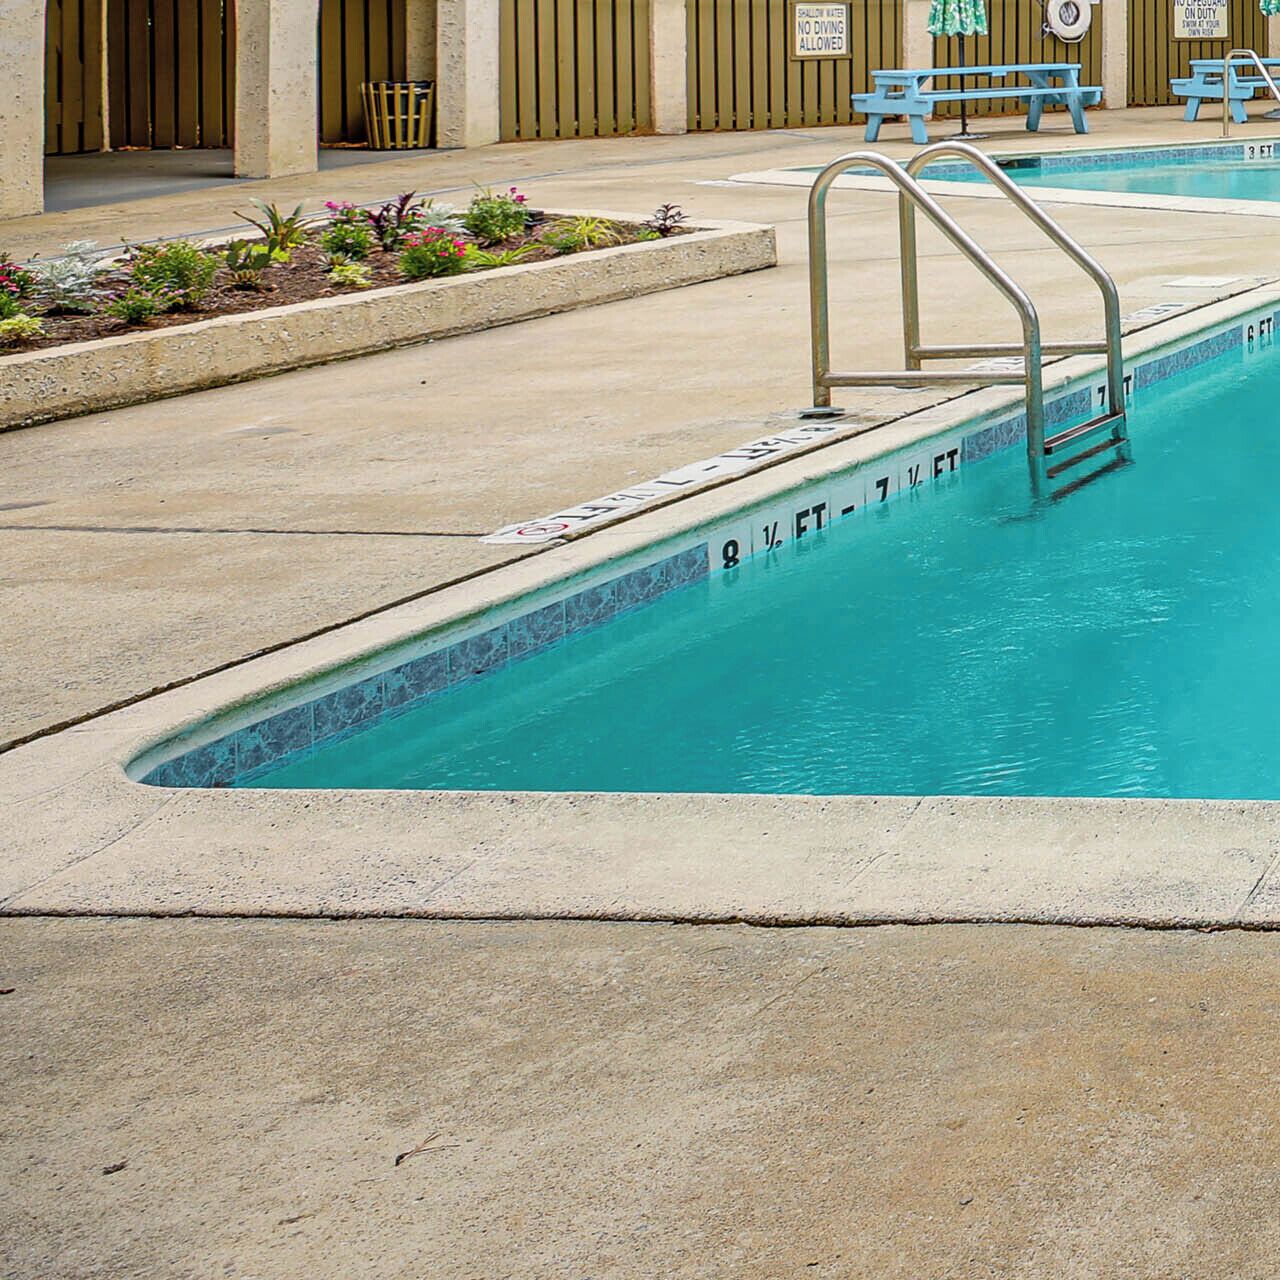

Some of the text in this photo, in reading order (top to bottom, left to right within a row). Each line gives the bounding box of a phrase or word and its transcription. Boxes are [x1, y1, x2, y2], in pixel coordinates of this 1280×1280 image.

[798, 8, 844, 18] SHALLOW WATER
[1185, 7, 1217, 20] ON DUTY
[798, 20, 844, 35] NO DIVING
[800, 36, 843, 51] ALLOWED
[1248, 317, 1273, 342] 6 FT
[1097, 384, 1106, 407] 7
[554, 506, 619, 521] FT
[722, 539, 740, 569] 8
[795, 502, 827, 540] FT
[876, 476, 889, 502] 7
[933, 448, 959, 479] FT
